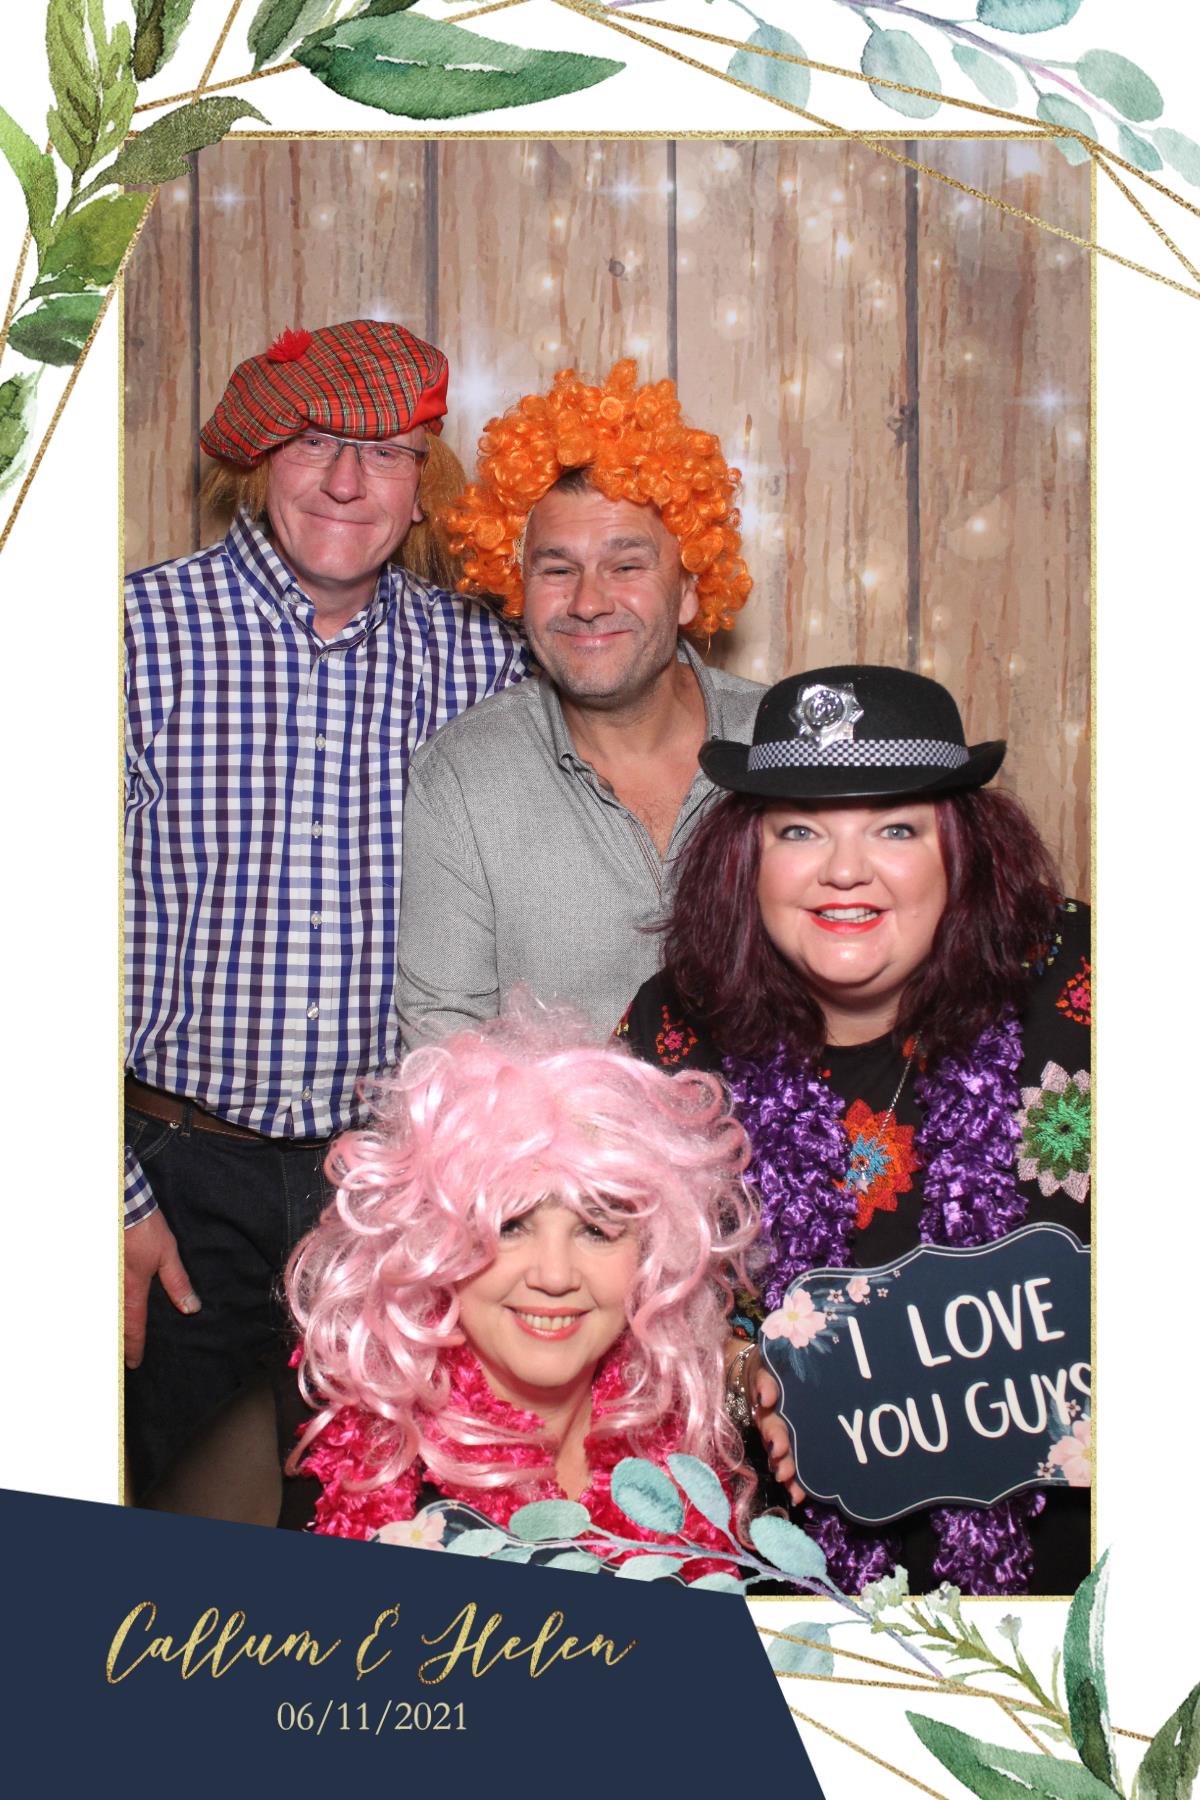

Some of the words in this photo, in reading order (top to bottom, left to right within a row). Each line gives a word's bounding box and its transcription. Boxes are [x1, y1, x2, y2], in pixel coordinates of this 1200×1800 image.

[847, 1316, 872, 1379] I
[906, 1277, 1065, 1367] LOVE
[837, 1393, 948, 1464] YOU
